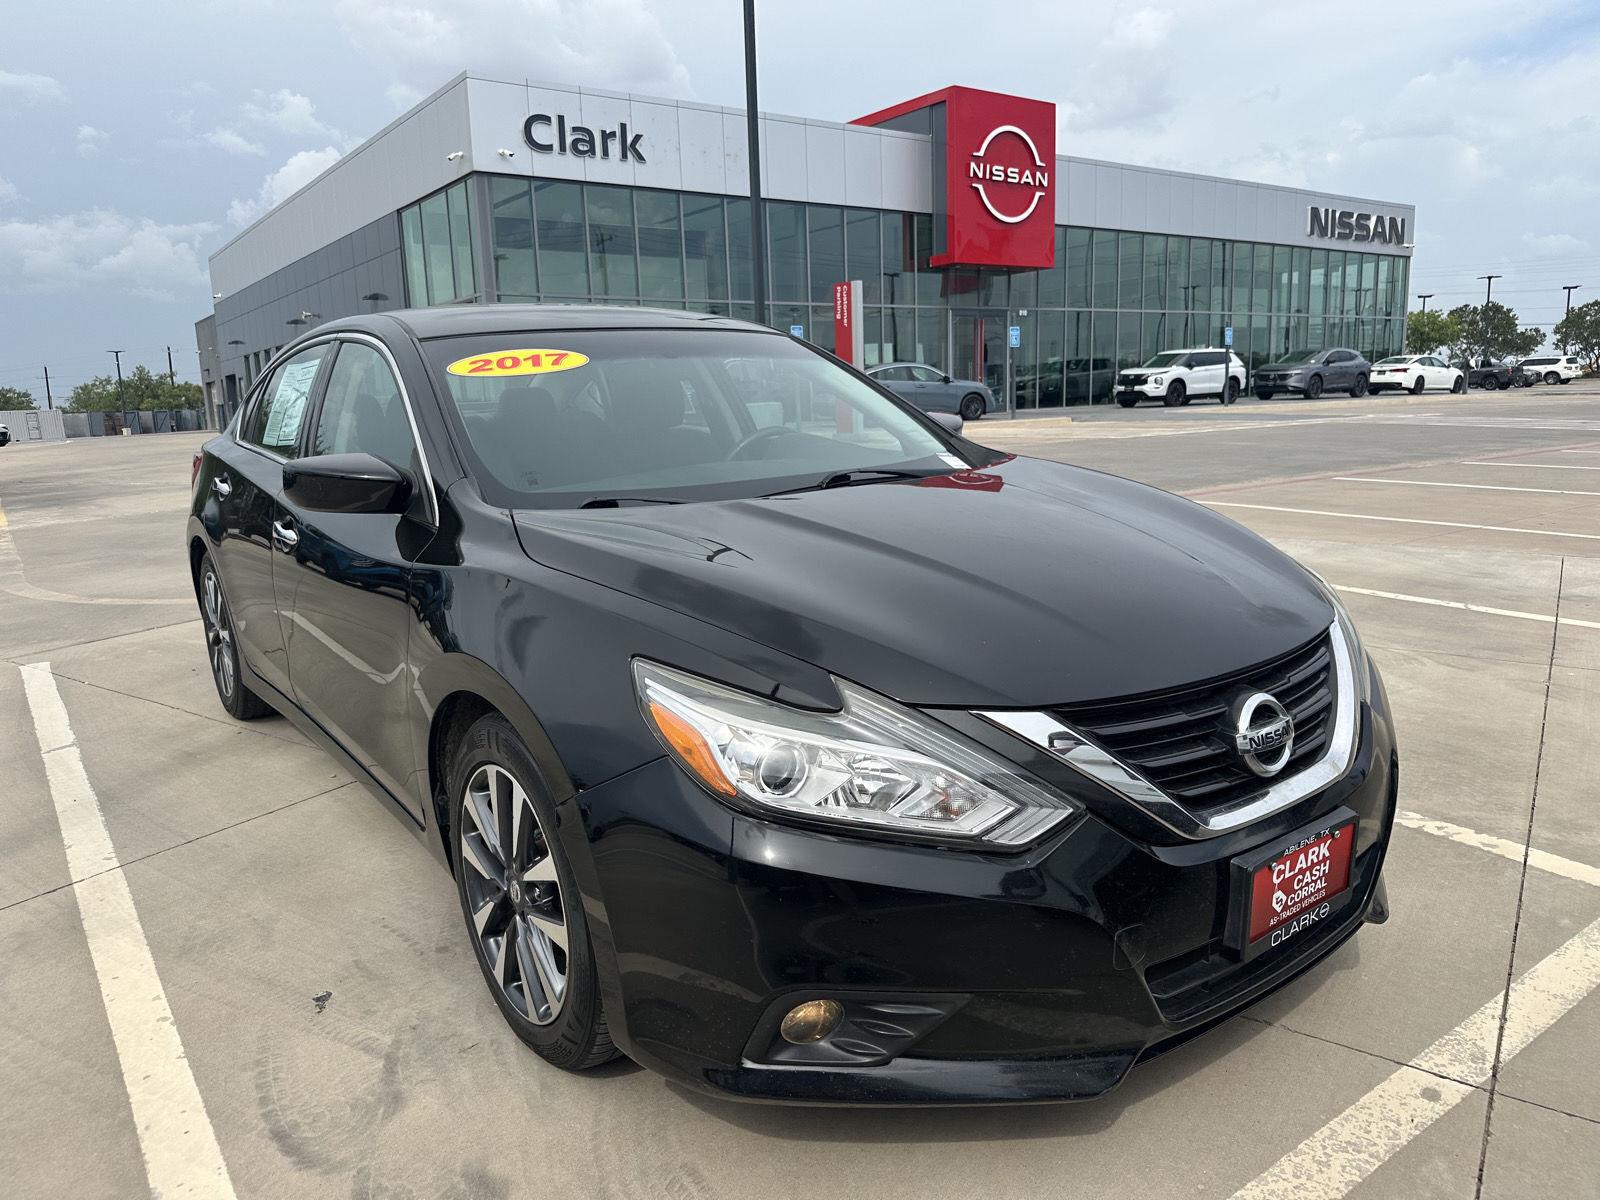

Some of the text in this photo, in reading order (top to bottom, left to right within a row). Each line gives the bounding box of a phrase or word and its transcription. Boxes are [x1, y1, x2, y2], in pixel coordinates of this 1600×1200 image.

[523, 113, 647, 163] Clark
[969, 161, 1048, 187] NISSAN
[1307, 206, 1406, 245] NISSAN
[467, 352, 569, 374] 2017
[1320, 827, 1331, 839] TX
[1272, 839, 1332, 884] CLARK
[1293, 860, 1330, 890] CASH
[1287, 877, 1328, 906] CORRAL
[1301, 890, 1326, 909] VEHICLES
[1271, 907, 1320, 947] CLARK
